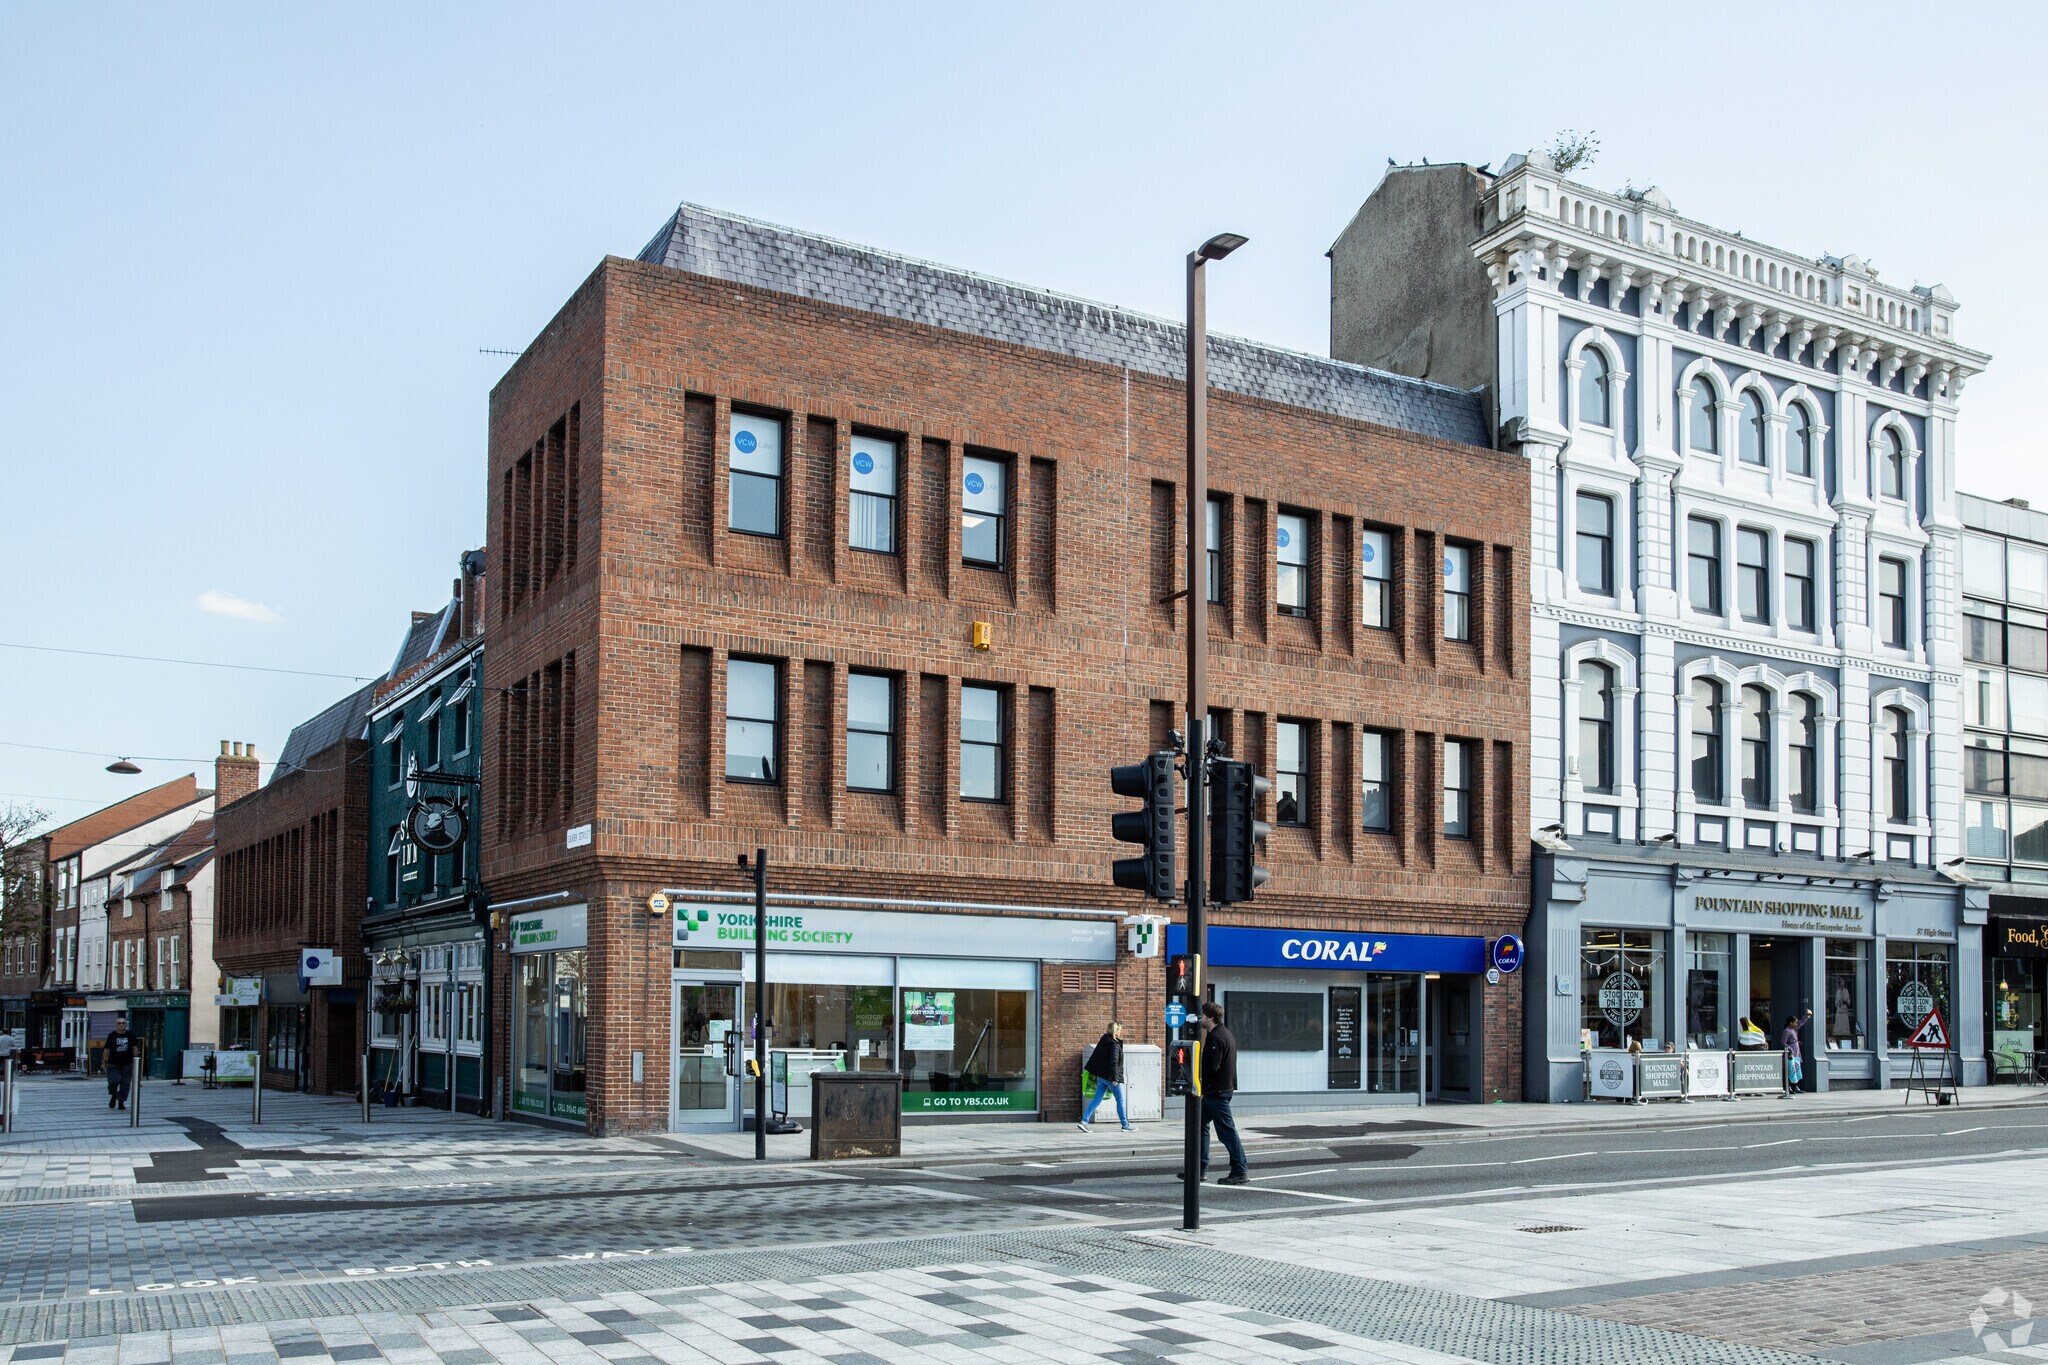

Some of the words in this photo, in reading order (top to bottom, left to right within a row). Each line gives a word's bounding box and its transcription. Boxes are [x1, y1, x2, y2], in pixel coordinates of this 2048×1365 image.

[737, 437, 755, 447] VCW
[855, 459, 872, 468] VCW
[966, 479, 983, 488] VCW
[653, 900, 665, 908] ADT
[1695, 896, 1764, 914] FOUNTAIN
[1765, 901, 1828, 918] SHOPPING
[1829, 904, 1864, 920] MALL
[1781, 920, 1799, 929] Home
[1799, 921, 1806, 929] of
[1806, 921, 1815, 930] the
[717, 927, 788, 942] BUILNG
[792, 930, 854, 944] SOCIETY
[1923, 928, 1937, 937] High
[1937, 929, 1952, 937] Street
[2007, 927, 2039, 947] Food,
[1281, 938, 1373, 962] CORAL
[1901, 998, 1930, 1006] STOCTON
[1645, 1064, 1677, 1072] FOUNTAIN
[1744, 1064, 1774, 1072] FOUNTAIN
[1645, 1072, 1677, 1080] SHOPPING
[1736, 1073, 1765, 1081] SHOPPING
[1652, 1079, 1670, 1087] MALL
[934, 1097, 947, 1106] GO
[948, 1097, 961, 1106] TO
[963, 1097, 1009, 1106] YBS.CO.UK
